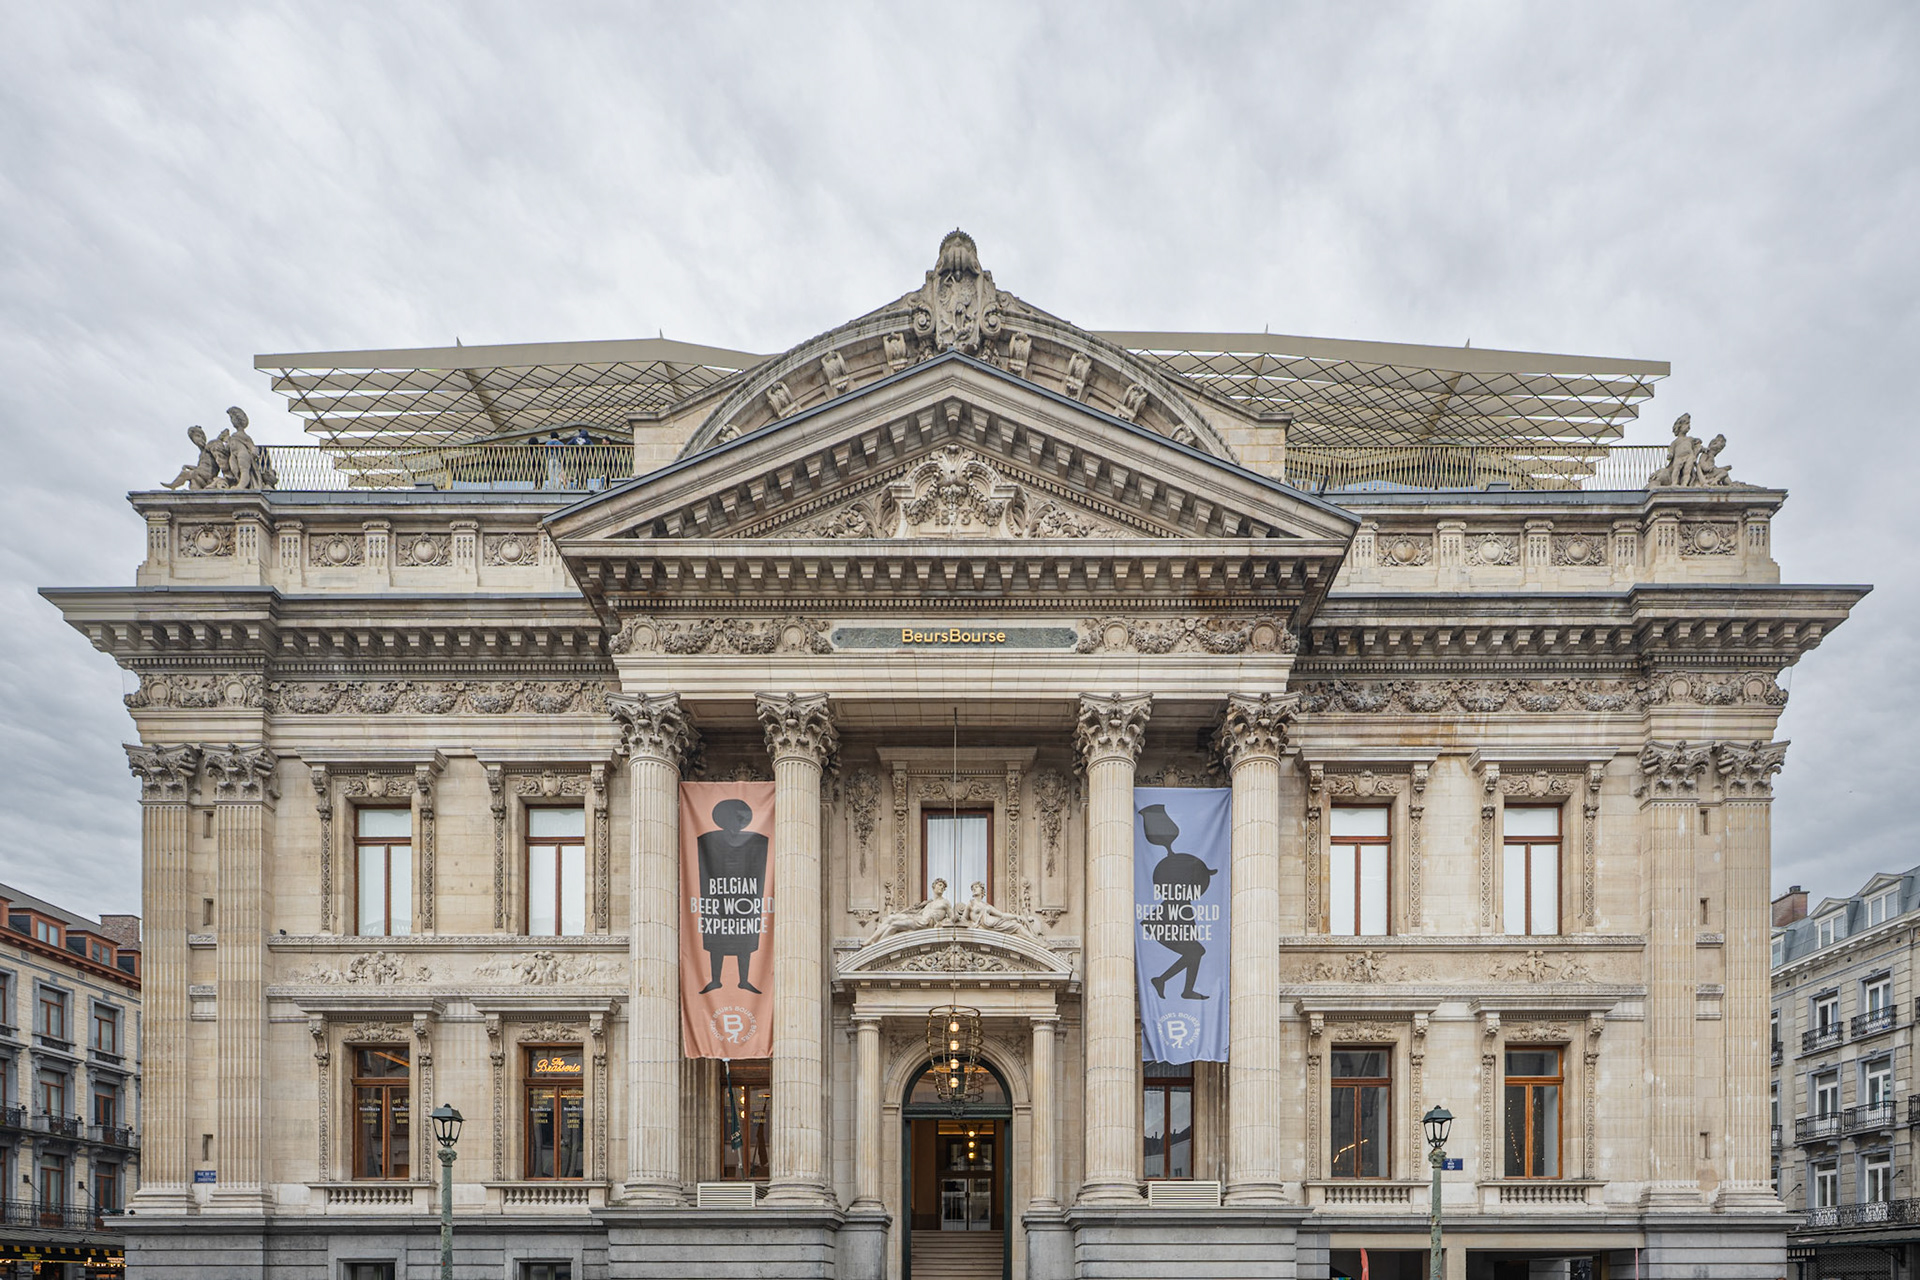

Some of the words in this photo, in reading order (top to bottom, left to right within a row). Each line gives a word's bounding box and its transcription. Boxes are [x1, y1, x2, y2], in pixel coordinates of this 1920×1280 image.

[935, 508, 972, 526] 1873
[902, 628, 1006, 643] BeursBourse
[690, 897, 719, 915] BEER
[723, 897, 775, 915] WORLD
[1136, 903, 1164, 921] BEER
[1168, 904, 1220, 921] WORLD
[535, 1059, 581, 1072] Brasserie
